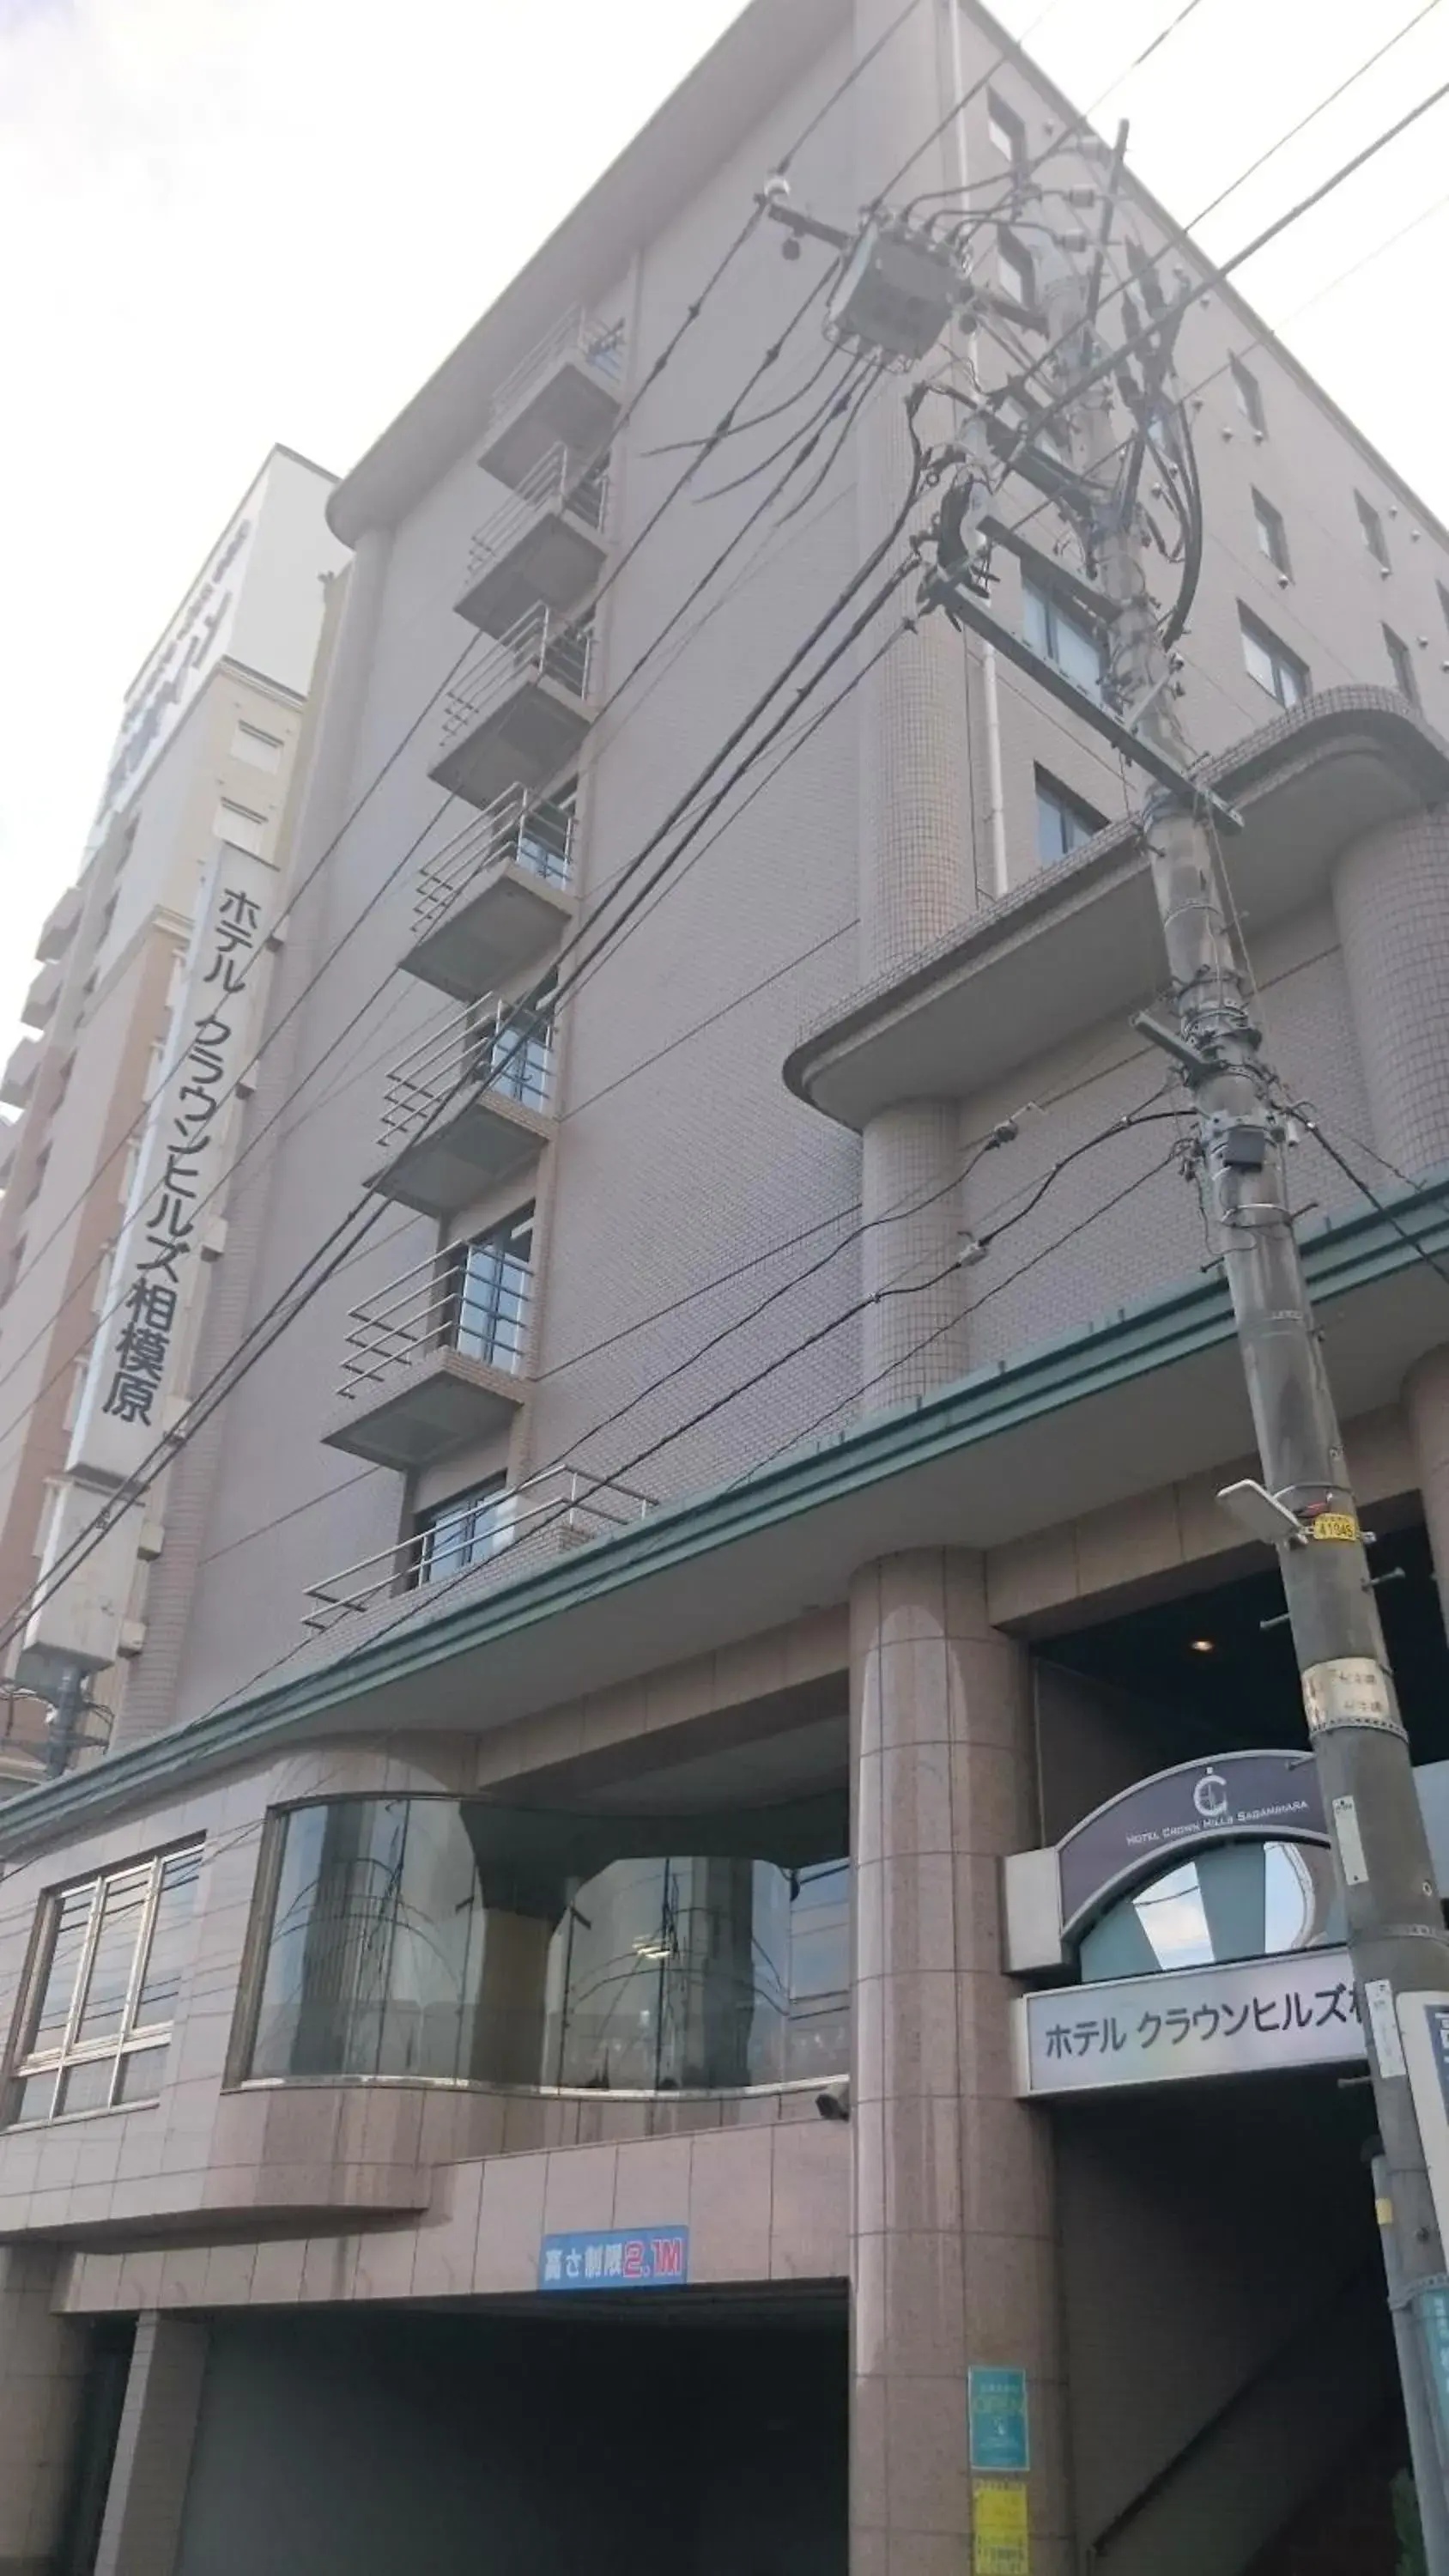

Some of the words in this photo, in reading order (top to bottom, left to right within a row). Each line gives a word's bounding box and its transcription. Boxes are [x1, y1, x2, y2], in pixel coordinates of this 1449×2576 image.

[203, 888, 261, 993] ホテル
[1126, 1831, 1160, 1845] HOTEL
[1162, 1821, 1200, 1839] CROWN
[1203, 1815, 1234, 1829] HILLS
[1046, 2018, 1127, 2059] ホテル
